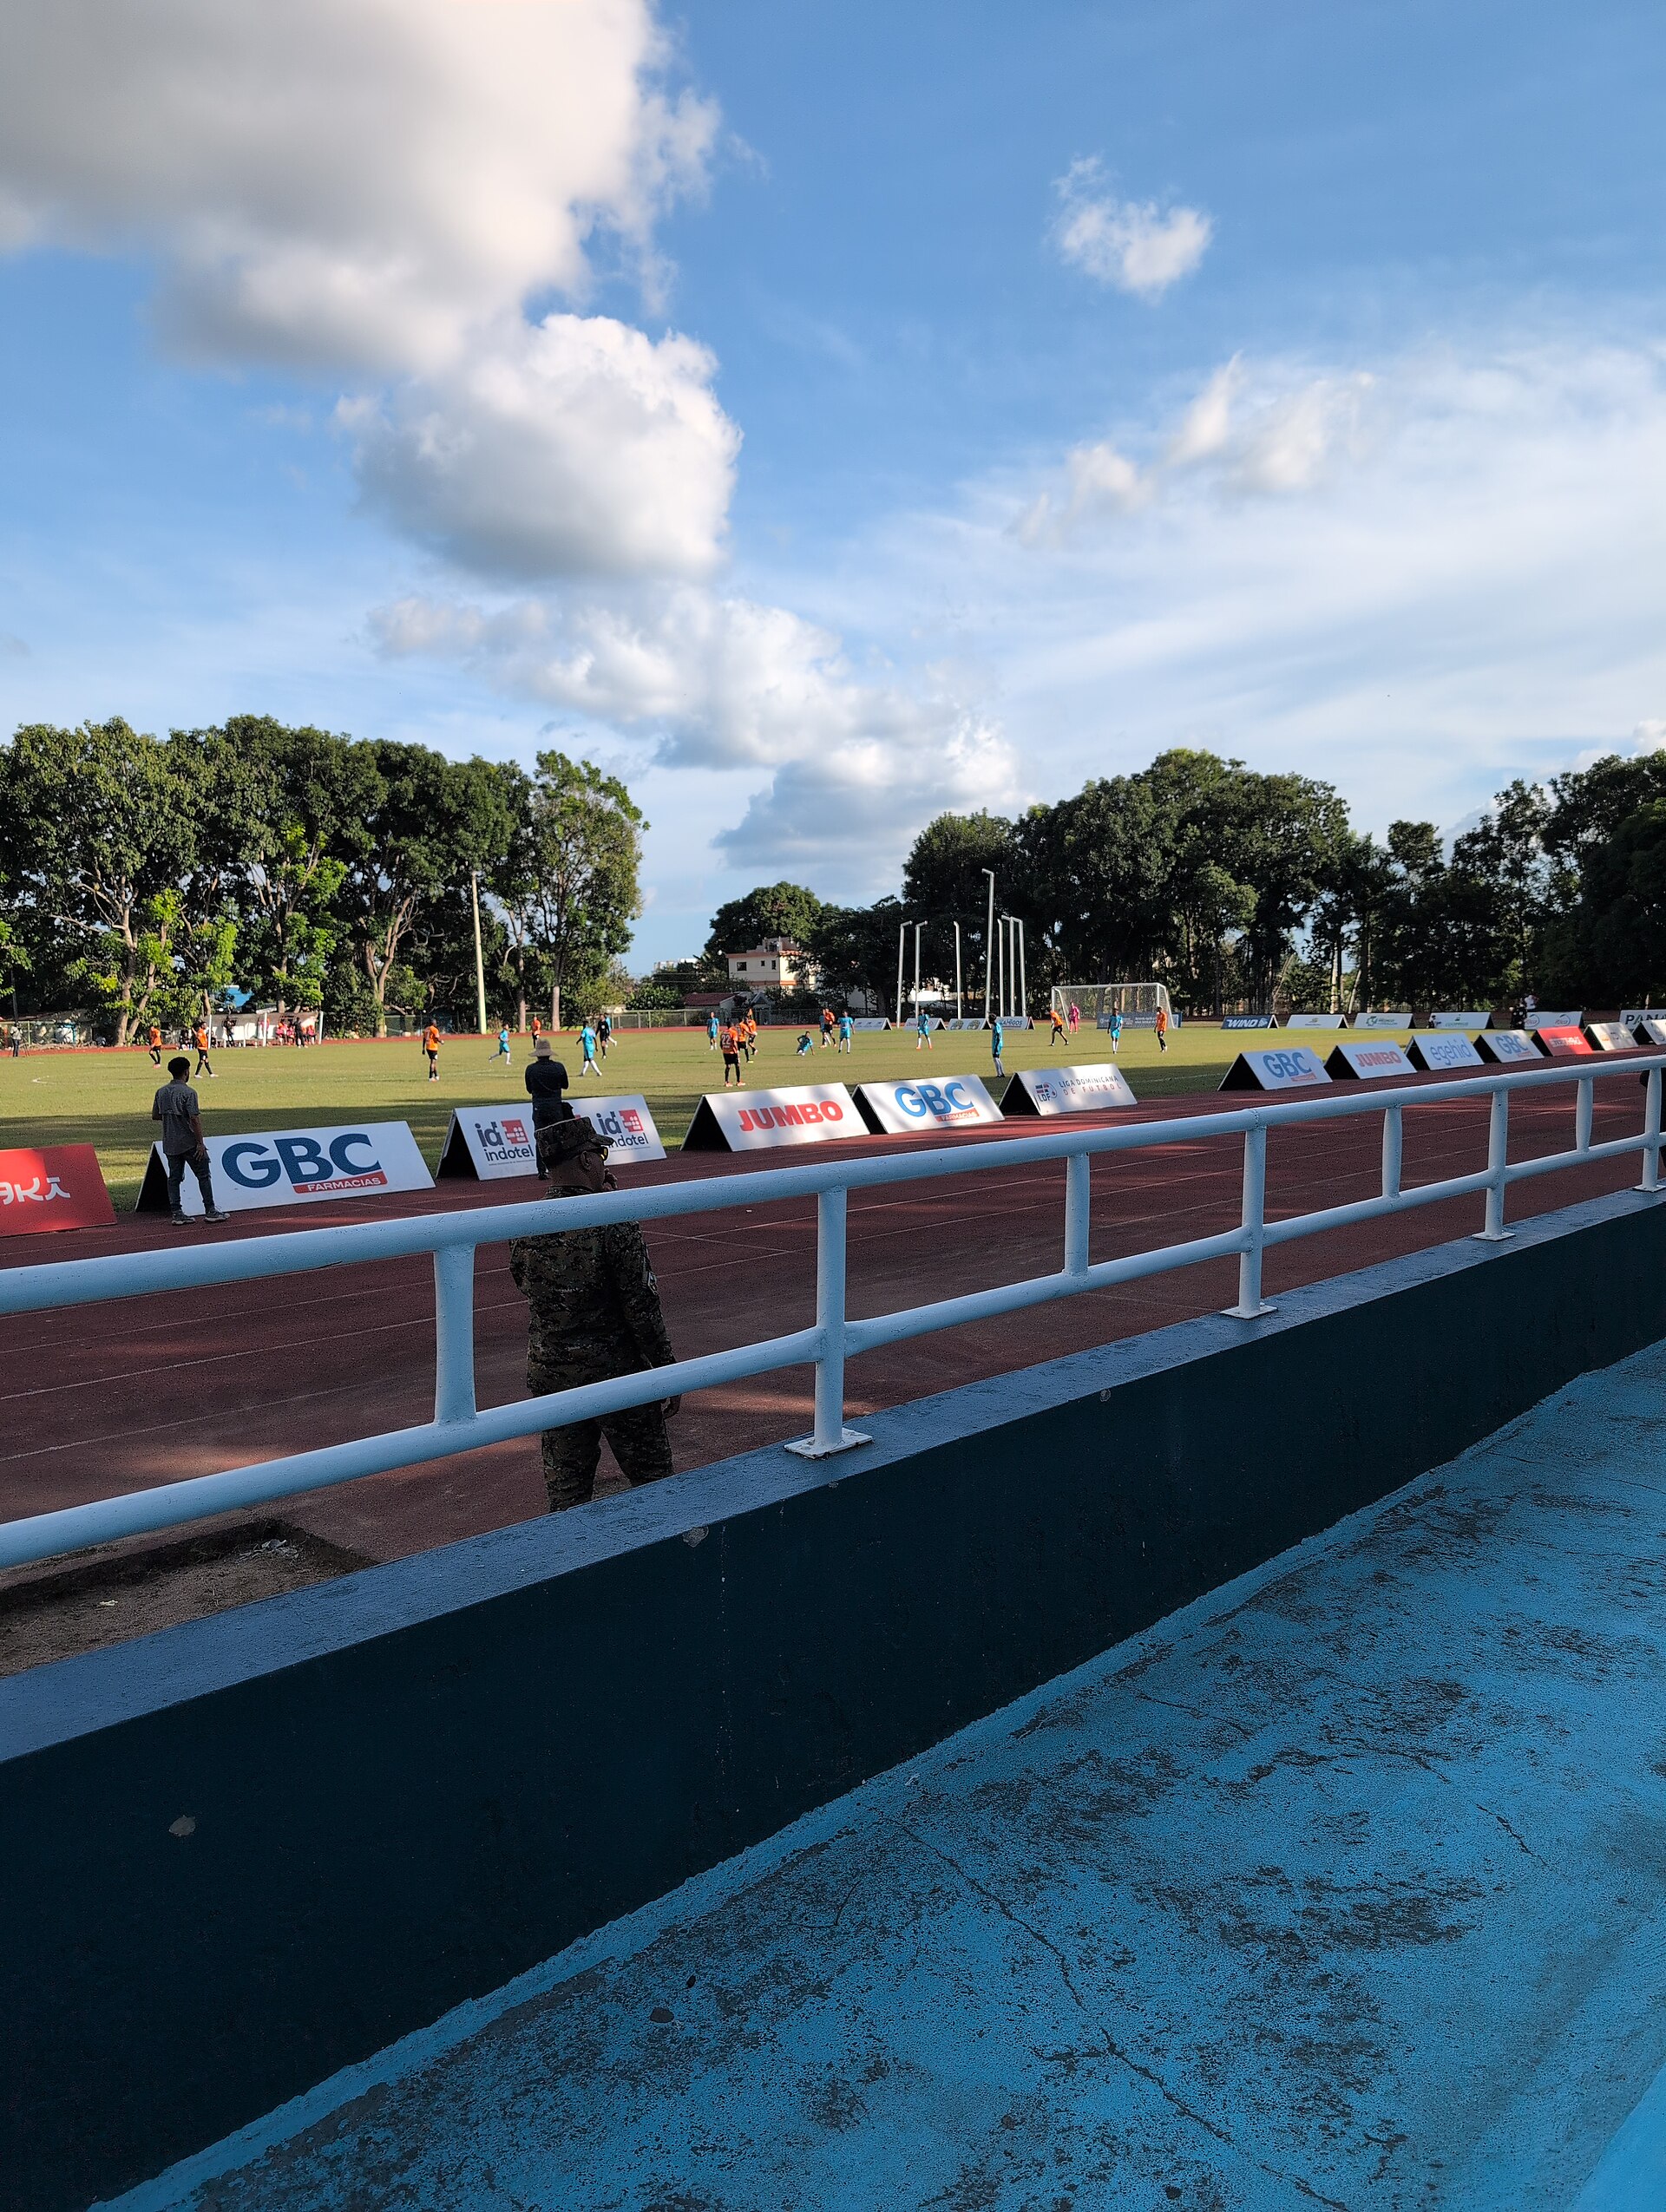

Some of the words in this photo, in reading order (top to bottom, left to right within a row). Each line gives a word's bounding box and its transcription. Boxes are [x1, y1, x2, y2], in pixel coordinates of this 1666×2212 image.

[1226, 1018, 1258, 1028] WIND
[721, 1034, 731, 1045] 22
[1495, 1034, 1529, 1055] GBC
[1354, 1050, 1402, 1068] JUMBO
[1429, 1039, 1473, 1066] egehid
[1263, 1051, 1313, 1078] GBC
[1059, 1080, 1076, 1089] LIGA
[1076, 1075, 1118, 1086] DOMINICANA
[895, 1082, 974, 1118] GBC
[1038, 1093, 1052, 1103] LDF
[1063, 1087, 1076, 1096] DE
[738, 1100, 843, 1132] JUMBO
[607, 1132, 649, 1149] ndotel
[221, 1133, 383, 1188] GBC
[483, 1143, 535, 1162] indotel
[307, 1177, 382, 1192] FARMACIAS
